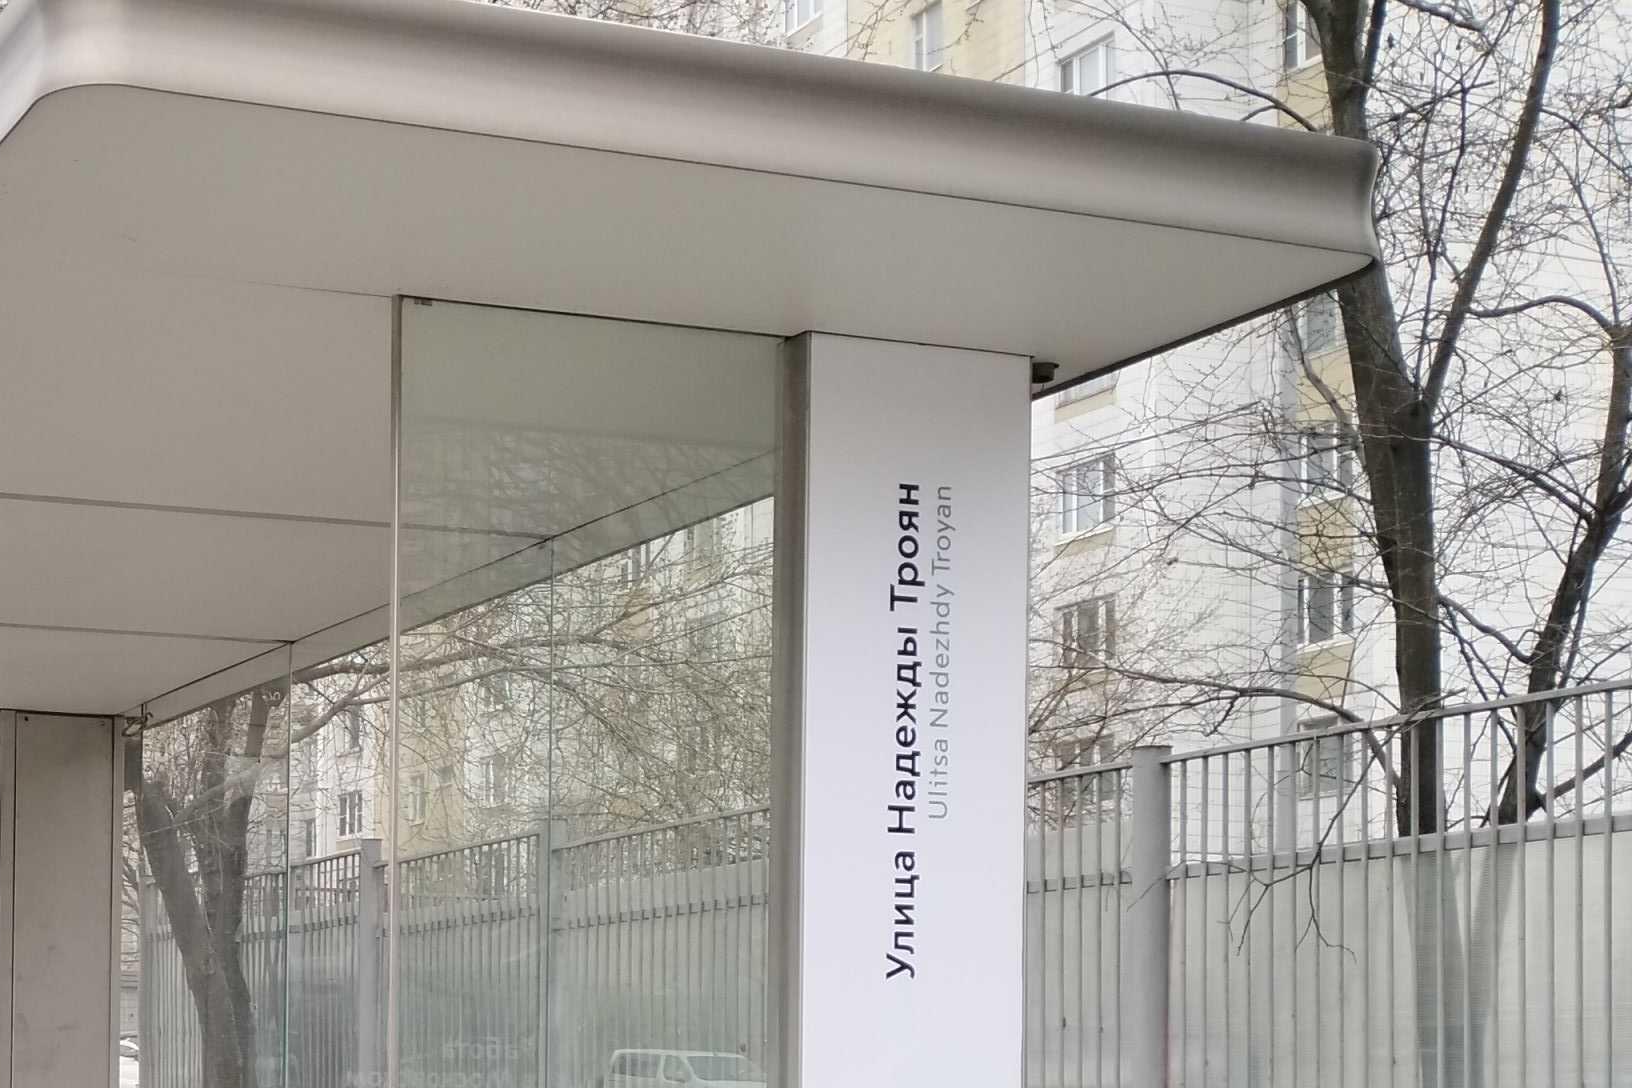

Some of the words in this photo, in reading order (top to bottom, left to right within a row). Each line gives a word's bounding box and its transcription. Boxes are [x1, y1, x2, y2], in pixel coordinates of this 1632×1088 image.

[889, 483, 925, 611] Троян
[931, 486, 956, 575] Troyan
[929, 584, 955, 728] Nadezhdy
[887, 627, 922, 834] Надежды
[928, 739, 948, 819] Ulitsa
[886, 851, 920, 979] Улица
